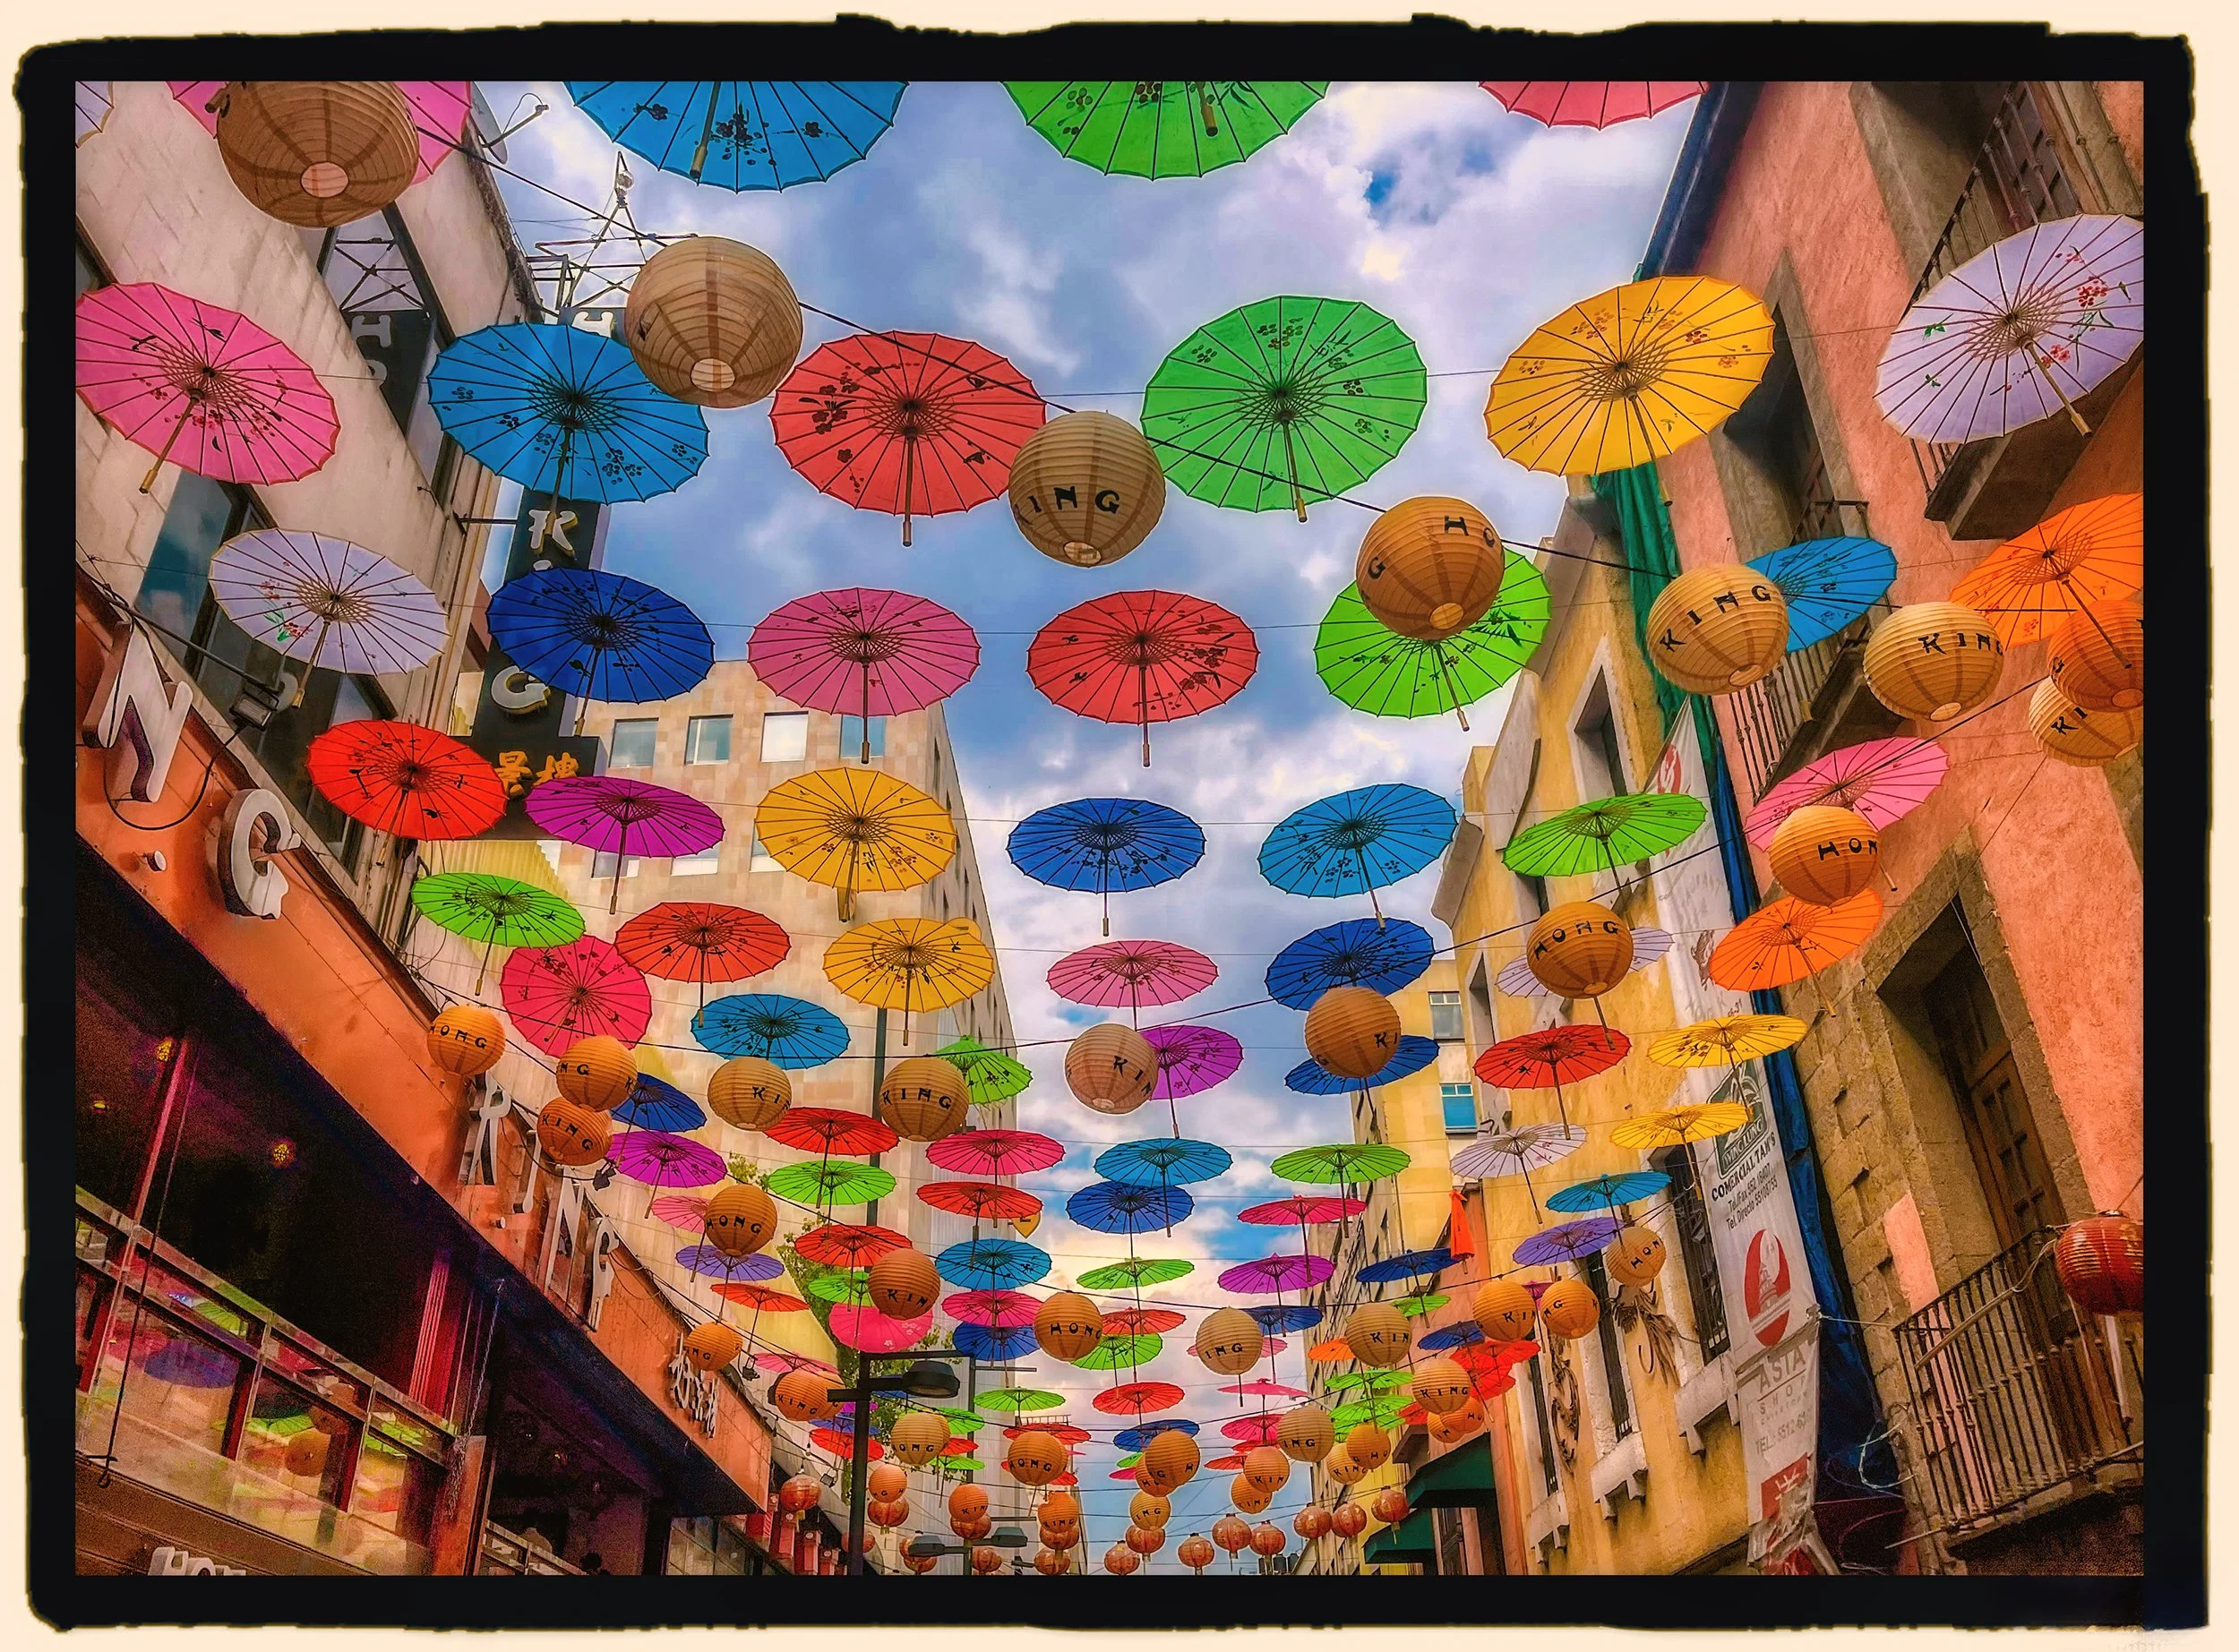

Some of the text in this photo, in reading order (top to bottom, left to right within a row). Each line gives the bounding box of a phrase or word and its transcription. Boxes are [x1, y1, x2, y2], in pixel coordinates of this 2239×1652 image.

[1660, 585, 1771, 653] KING
[1533, 920, 1618, 961] HONG
[882, 1087, 952, 1110] KING
[541, 1114, 593, 1151] KING
[1711, 1156, 1755, 1202] COMERCIAL
[706, 1215, 762, 1235] HONG
[1737, 1200, 1754, 1223] Directo
[1760, 1346, 1806, 1393] ASIA
[778, 1394, 817, 1415] KING
[1420, 1386, 1468, 1399] KING
